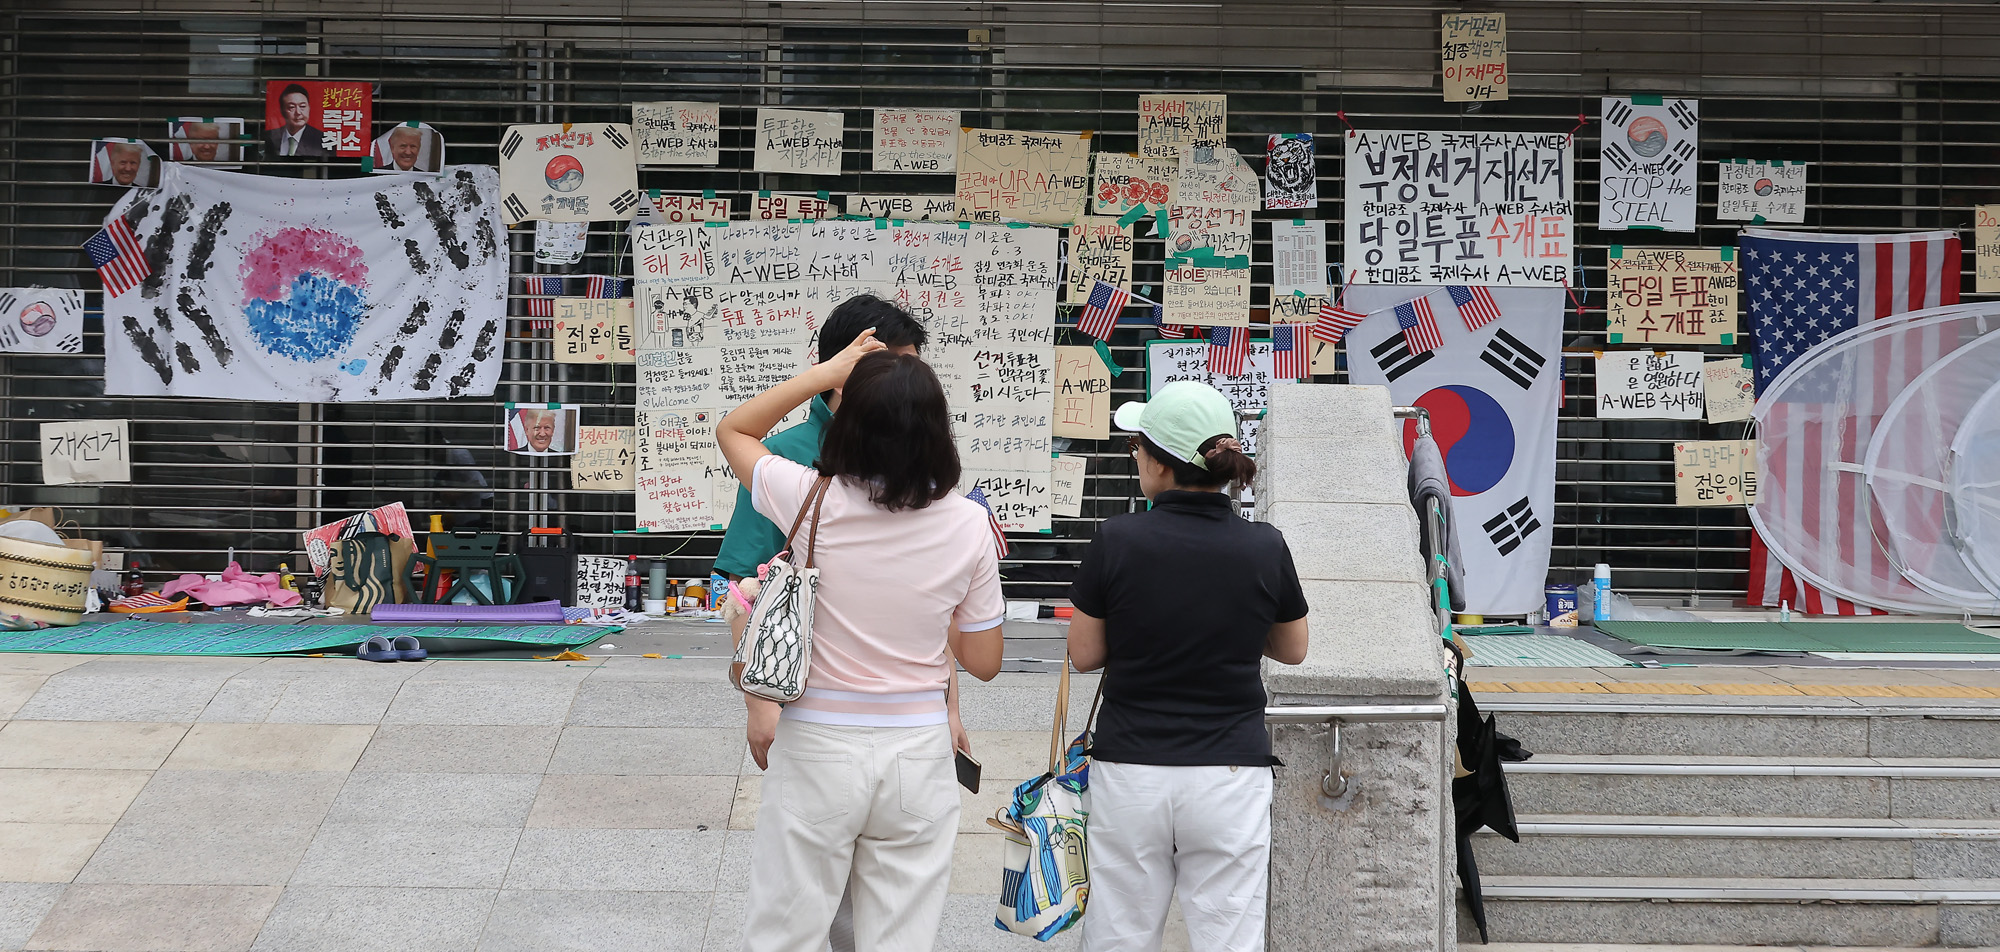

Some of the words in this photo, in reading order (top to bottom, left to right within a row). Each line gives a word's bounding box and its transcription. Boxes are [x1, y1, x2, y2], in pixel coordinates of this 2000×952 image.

[1445, 63, 1506, 84] 이재명
[1466, 85, 1497, 99] 이다
[322, 110, 363, 130] 즉각
[1149, 116, 1191, 130] A-WEB
[321, 131, 361, 151] 취소
[641, 138, 683, 150] A-WEB
[767, 138, 810, 150] A-WEB
[977, 132, 1016, 147] 한미공조
[1020, 133, 1062, 149] 국제수사
[1355, 132, 1431, 153] A-WEB
[1442, 133, 1511, 152] 국제수사
[1516, 134, 1566, 150] A-WEB
[893, 160, 939, 170] A-WEB
[1627, 162, 1665, 176] A-WEB
[1048, 173, 1087, 189] A-WEB
[1098, 174, 1131, 185] A-WEB
[1604, 176, 1664, 200] STOP
[1667, 178, 1692, 196] the
[859, 197, 913, 212] A-WEB
[1363, 202, 1408, 217] 한미공조
[1480, 202, 1524, 217] A-WEB
[1609, 202, 1673, 223] STEAL
[959, 208, 1001, 222] A-WEB
[1168, 205, 1246, 229] 부정선거
[637, 228, 693, 250] 선관위
[934, 231, 967, 247] 재선거
[1076, 235, 1132, 253] A-WEB
[1487, 214, 1567, 258] 수개표
[1637, 250, 1685, 263] A-WEB
[730, 263, 800, 283] A-WEB
[805, 262, 858, 281] 수사해
[895, 270, 957, 290] A-WEB
[1365, 266, 1422, 284] 한미공조
[1430, 265, 1490, 281] 국제수사
[1497, 264, 1567, 285] A-WEB
[666, 286, 714, 300] A-WEB
[719, 291, 737, 303] 다
[560, 301, 614, 319] 고맙다
[721, 308, 746, 327] 투표
[752, 308, 763, 326] 좀
[766, 306, 801, 321] 하자!
[1637, 310, 1706, 341] 수개표
[1627, 357, 1640, 370] 은
[1062, 379, 1109, 395] A-WEB
[1627, 376, 1640, 389] 은
[1644, 371, 1700, 390] 영원하다
[651, 396, 689, 408] Welcome
[1602, 393, 1656, 411] A-WEB
[50, 426, 122, 461] 재선거
[1684, 444, 1735, 468] 고맙다
[577, 469, 624, 487] A-WEB
[638, 477, 656, 490] 국제
[660, 475, 682, 487] 왕따
[1055, 480, 1072, 488] THE
[996, 503, 1008, 520] 집
